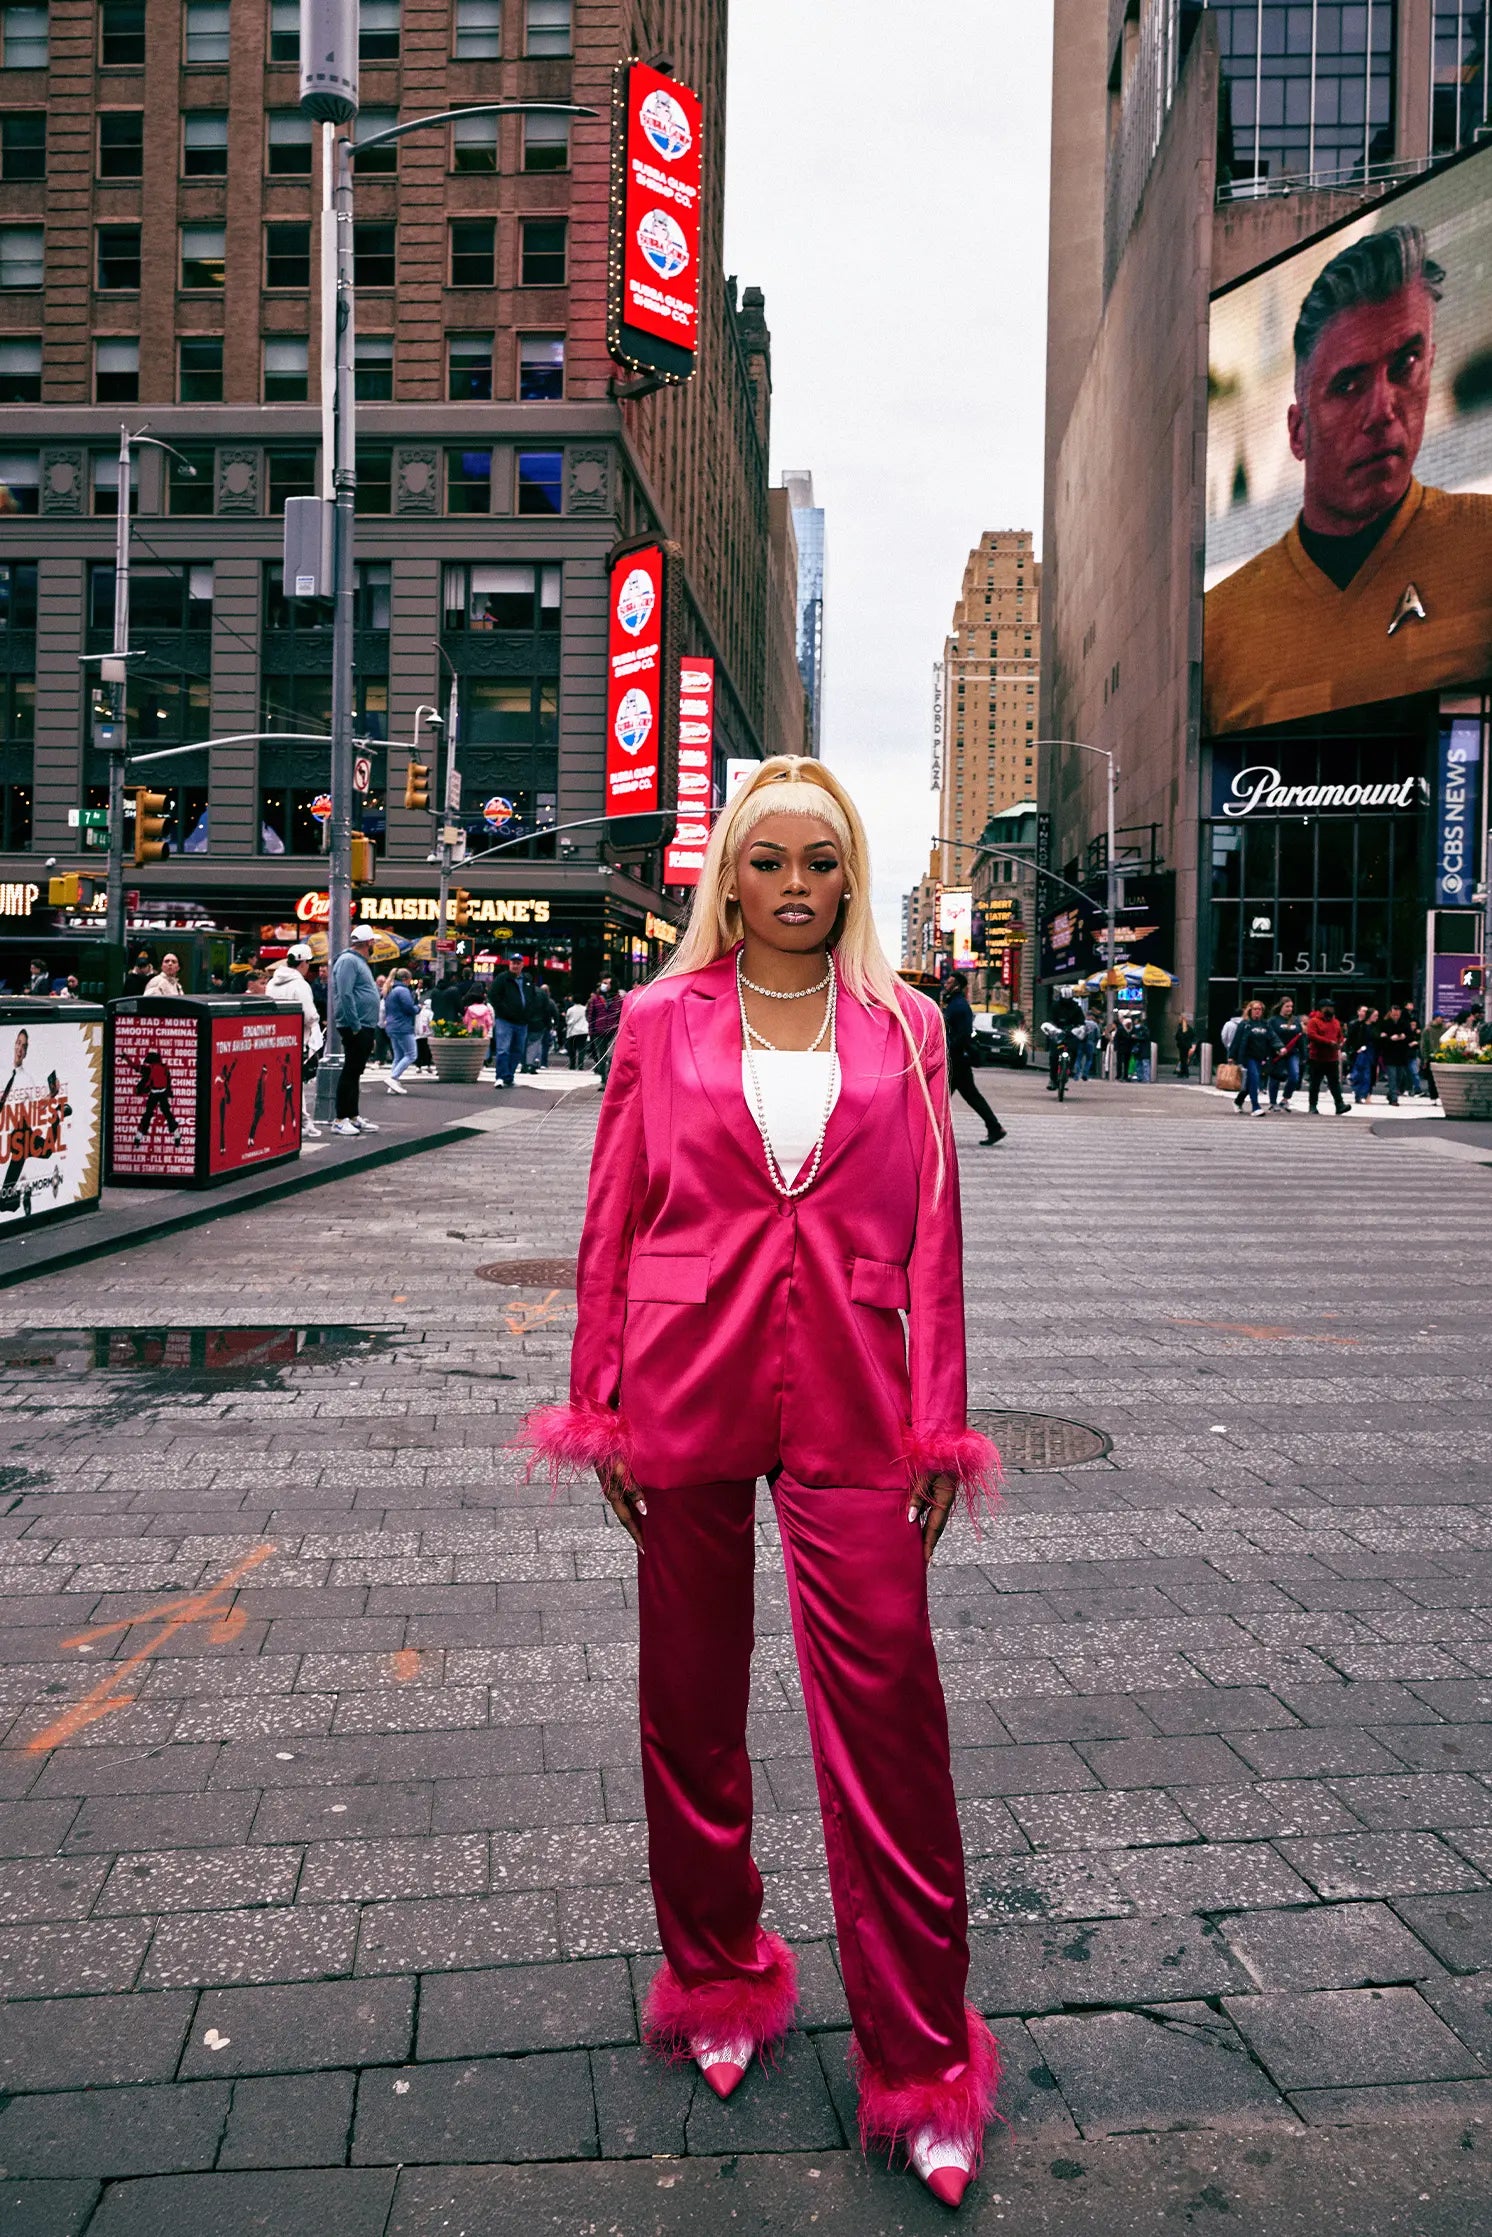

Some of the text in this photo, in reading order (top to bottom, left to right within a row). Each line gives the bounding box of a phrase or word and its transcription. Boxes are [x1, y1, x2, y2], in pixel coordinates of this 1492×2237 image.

[632, 158, 697, 197] BUBBA GUMP
[630, 279, 694, 315] BUBBA GUMP
[930, 739, 941, 791] PLAZA
[1222, 766, 1414, 817] Paramount
[1443, 748, 1467, 873] CBS NEWS
[85, 812, 91, 824] 7
[360, 897, 456, 920] RAISING
[1276, 952, 1356, 973] 1515
[115, 1017, 198, 1027] JAM BAD MONEY
[115, 1027, 198, 1037] SMOOTH CRIMINAL
[134, 1038, 149, 1046] JEAN
[115, 1047, 137, 1056] BLAME
[139, 1047, 147, 1056] IT
[160, 1048, 172, 1056] THE
[174, 1048, 198, 1057] BOOGIE
[188, 1057, 198, 1066] IT
[171, 1078, 197, 1087] CHINE
[114, 1087, 197, 1096] MAN IRROR
[153, 1135, 161, 1144] IN
[164, 1136, 196, 1145] MOCOW
[113, 1154, 146, 1163] THRILLER
[163, 1155, 173, 1163] BE
[174, 1155, 196, 1164] THERE
